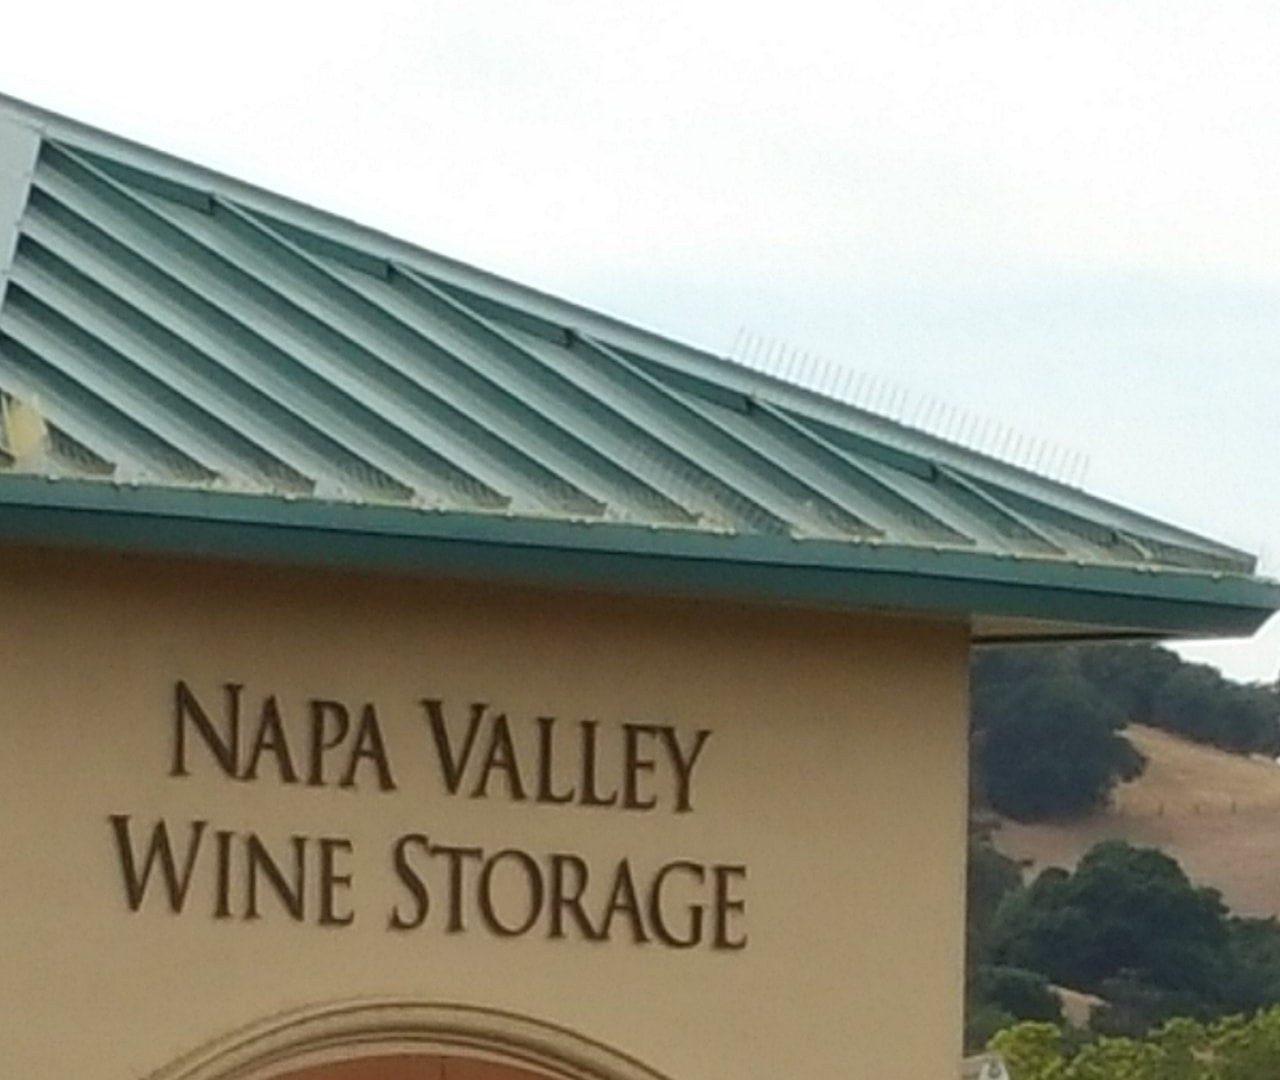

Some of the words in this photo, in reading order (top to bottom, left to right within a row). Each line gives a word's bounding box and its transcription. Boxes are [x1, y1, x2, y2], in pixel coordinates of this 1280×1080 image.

[169, 680, 397, 792] NAPA
[421, 698, 713, 812] VALLEY
[108, 814, 355, 928] WINE
[387, 834, 749, 951] STORAGE
